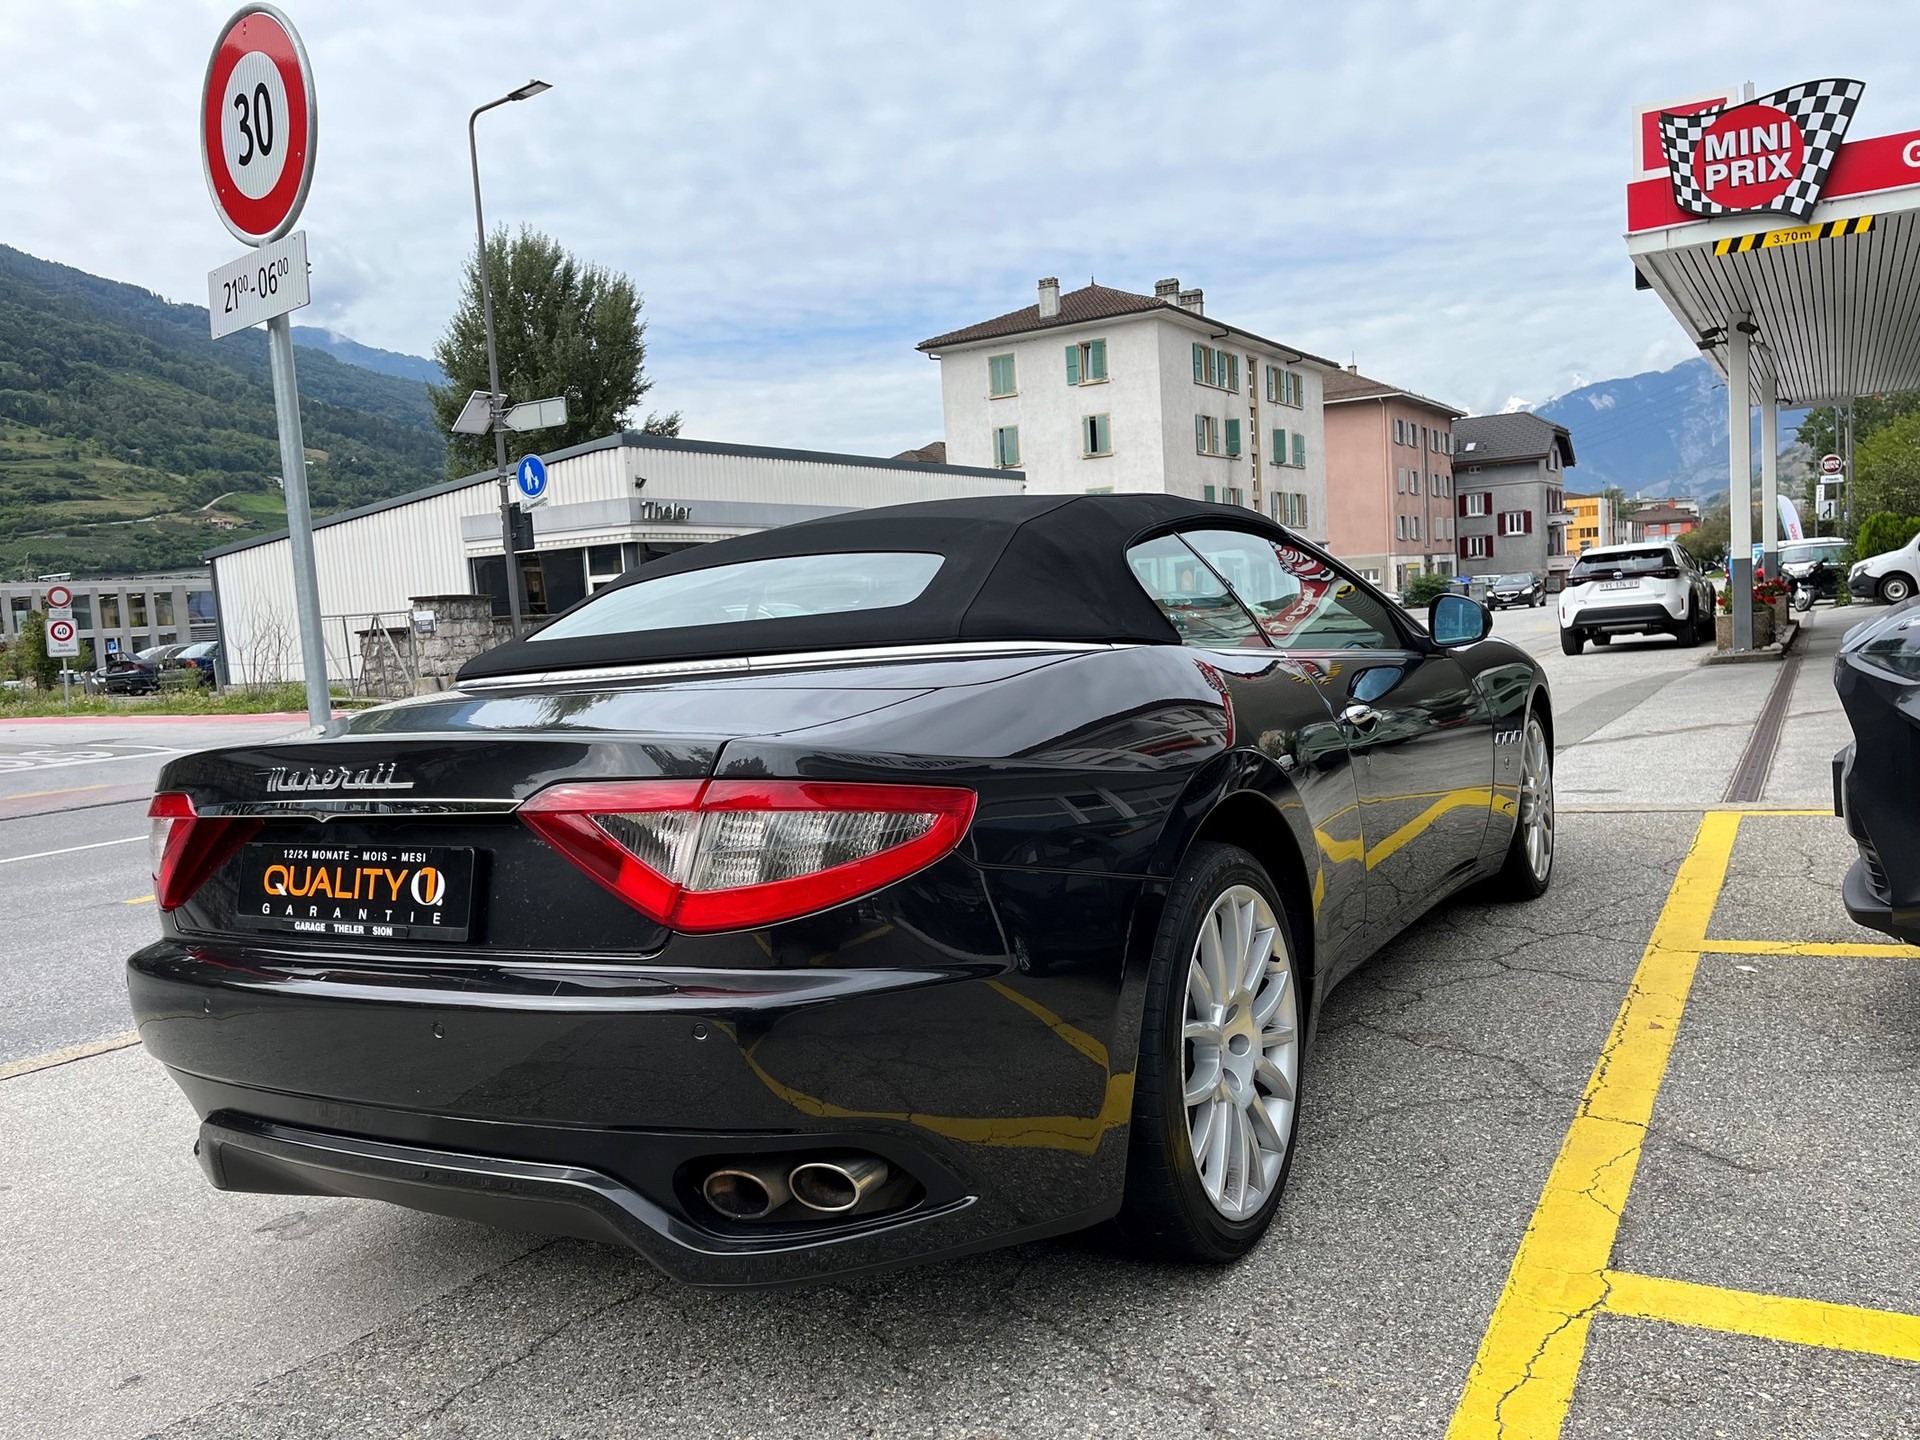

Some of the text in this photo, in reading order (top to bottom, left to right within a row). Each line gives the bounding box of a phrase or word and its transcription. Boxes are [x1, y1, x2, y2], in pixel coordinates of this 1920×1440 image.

[234, 82, 273, 166] 30
[1704, 121, 1791, 163] MINI
[1704, 152, 1793, 192] PRIX
[641, 501, 692, 520] Theler
[57, 627, 67, 635] 40
[255, 763, 415, 792] Maserati
[283, 849, 308, 859] 12/24
[312, 850, 350, 860] MONATE
[363, 851, 388, 862] MOIS
[401, 852, 426, 863] MESI
[263, 865, 409, 901] QUALITY
[262, 903, 441, 924] GARANTIE
[294, 921, 393, 936] GARAGE THELER SION
